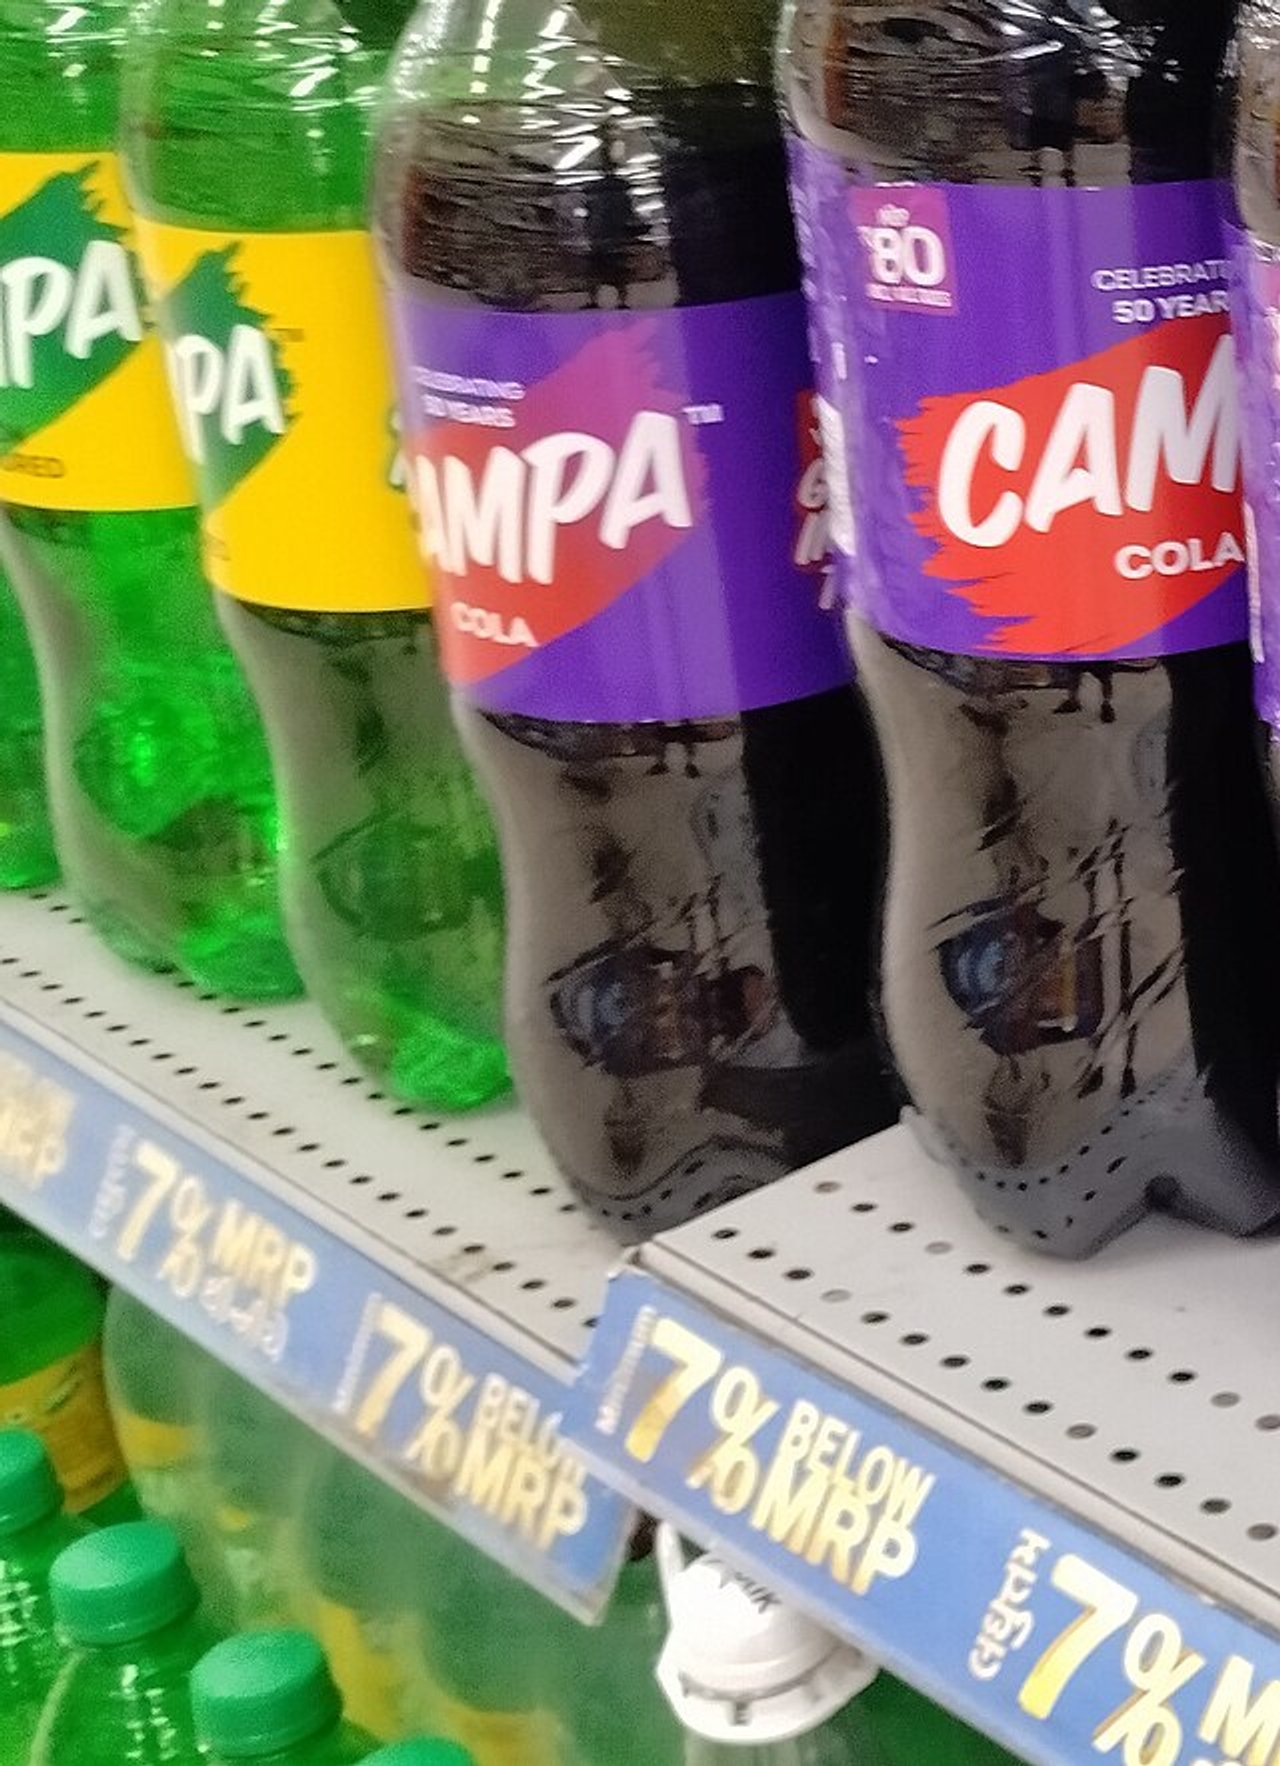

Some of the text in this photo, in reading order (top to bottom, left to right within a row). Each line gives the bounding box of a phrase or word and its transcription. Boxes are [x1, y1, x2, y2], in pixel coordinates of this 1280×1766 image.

[0, 240, 143, 389] PA
[1112, 299, 1154, 324] 50
[450, 602, 539, 647] COLA
[1114, 532, 1245, 579] COLA
[117, 1139, 212, 1298] 7%
[208, 1200, 319, 1298] MRP
[355, 1301, 475, 1478] 7%
[624, 1316, 781, 1516] 7%
[452, 1426, 588, 1552] MRP
[748, 1458, 919, 1597] MRP
[784, 1398, 937, 1530] BELOW
[1017, 1552, 1207, 1766] 7%
